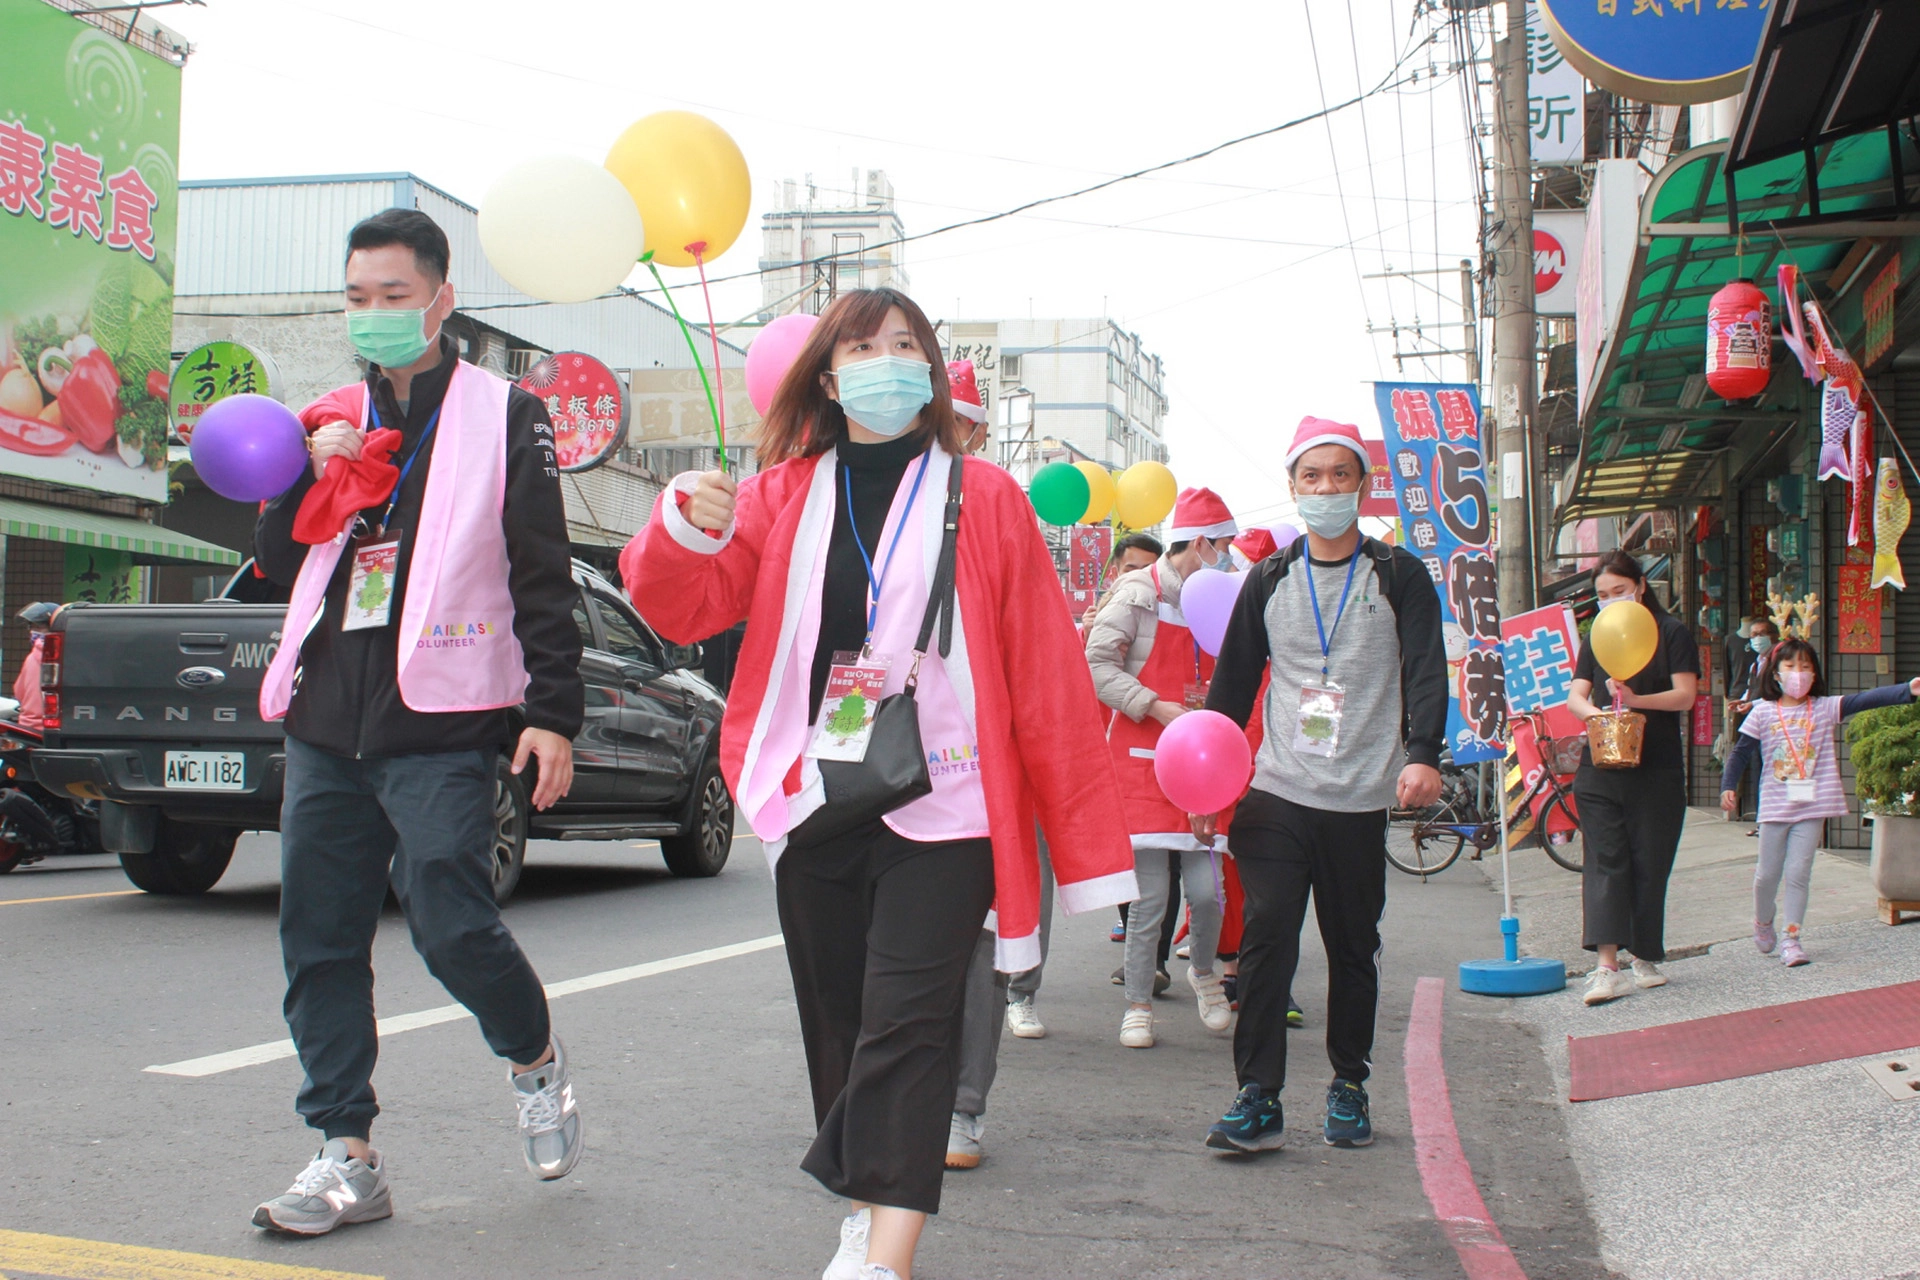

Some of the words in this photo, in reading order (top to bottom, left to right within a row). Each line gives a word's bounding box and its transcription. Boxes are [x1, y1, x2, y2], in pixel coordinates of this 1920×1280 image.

[177, 403, 214, 417] 健康
[1390, 388, 1479, 442] 振興
[1396, 451, 1444, 584] 歡迎使用
[167, 760, 242, 784] AWC-1182
